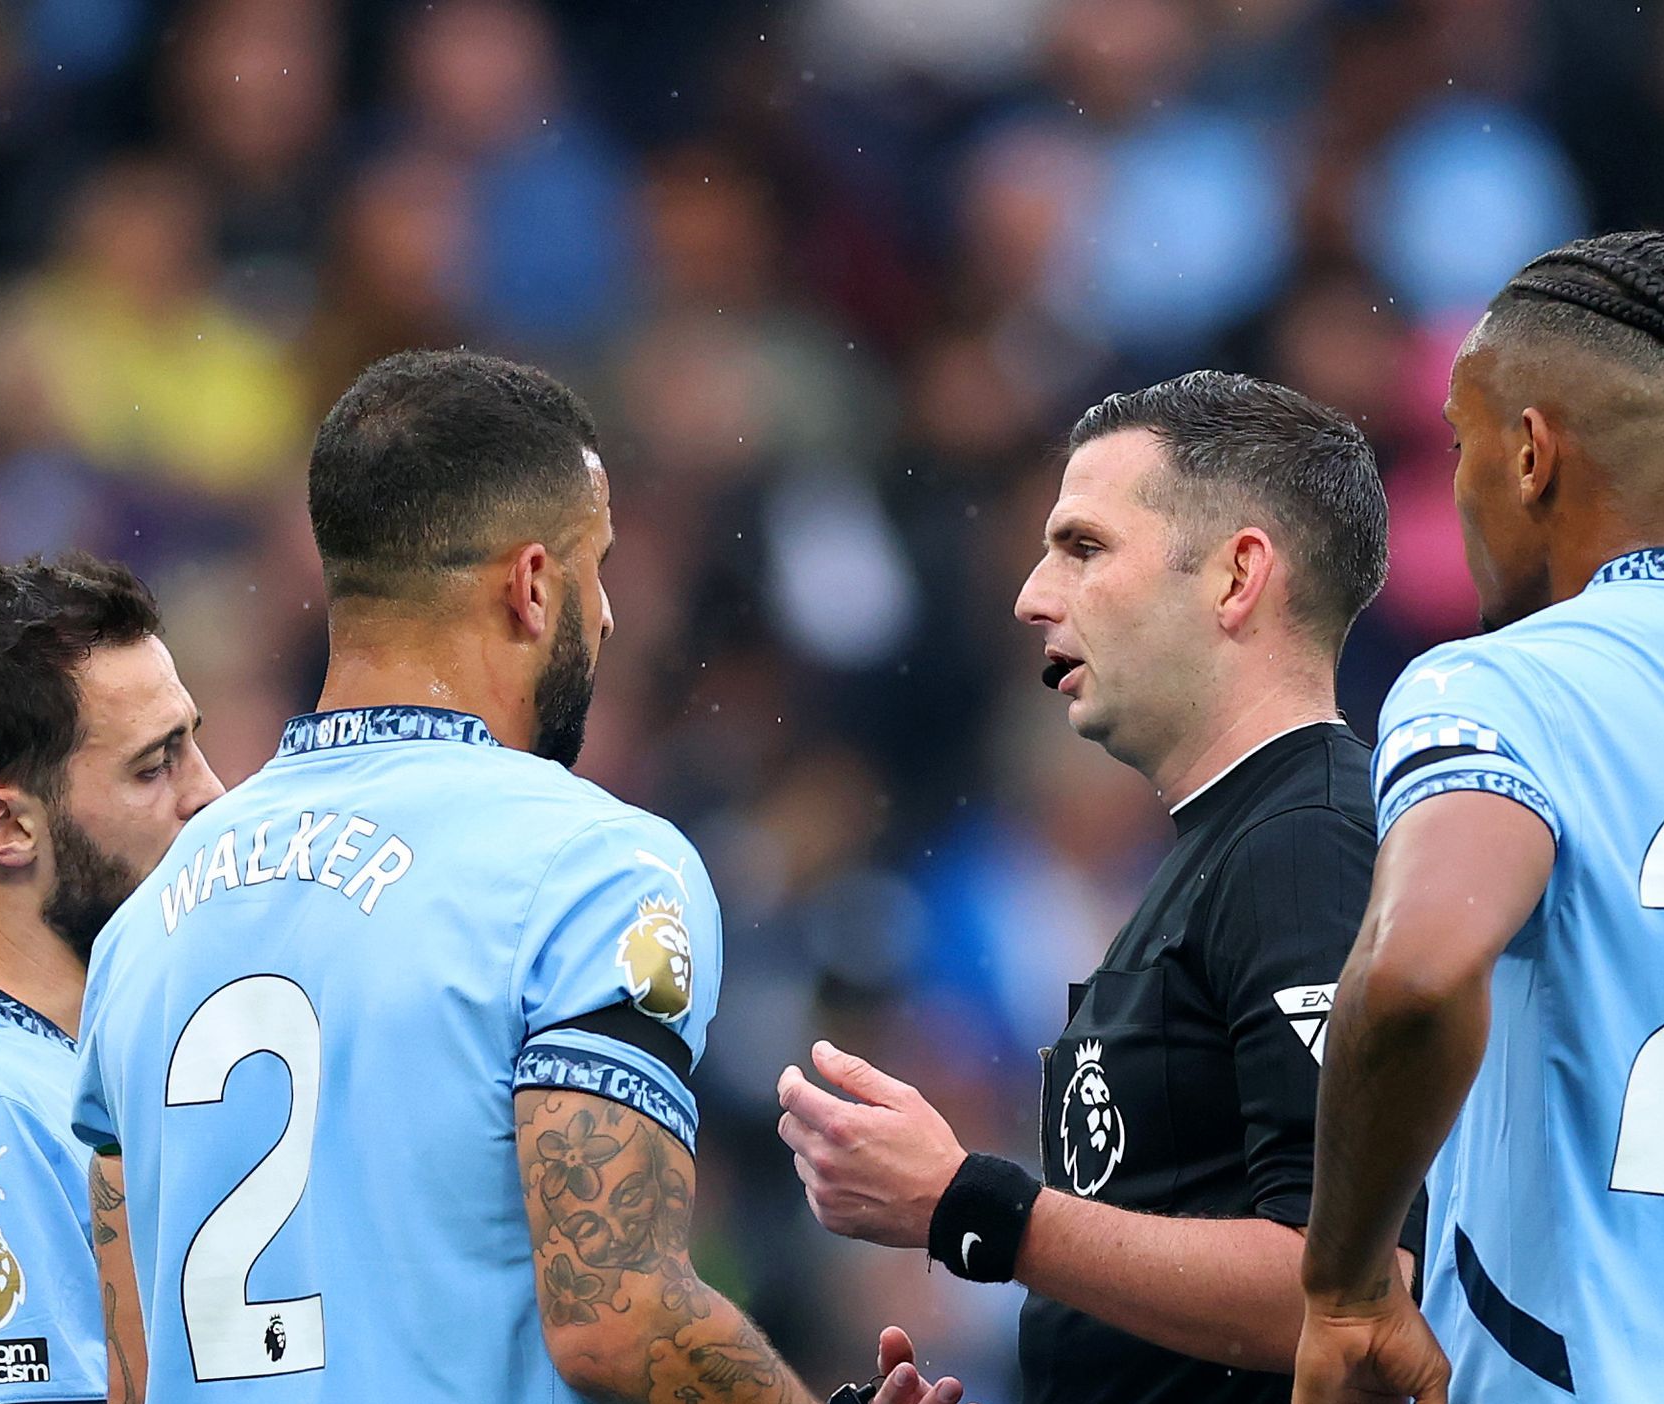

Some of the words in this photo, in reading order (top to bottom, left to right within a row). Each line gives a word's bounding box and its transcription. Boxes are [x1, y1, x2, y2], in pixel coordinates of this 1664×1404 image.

[316, 717, 360, 745] CITY
[159, 811, 414, 936] WALKER
[1301, 990, 1333, 1008] EA
[165, 973, 326, 1383] 2
